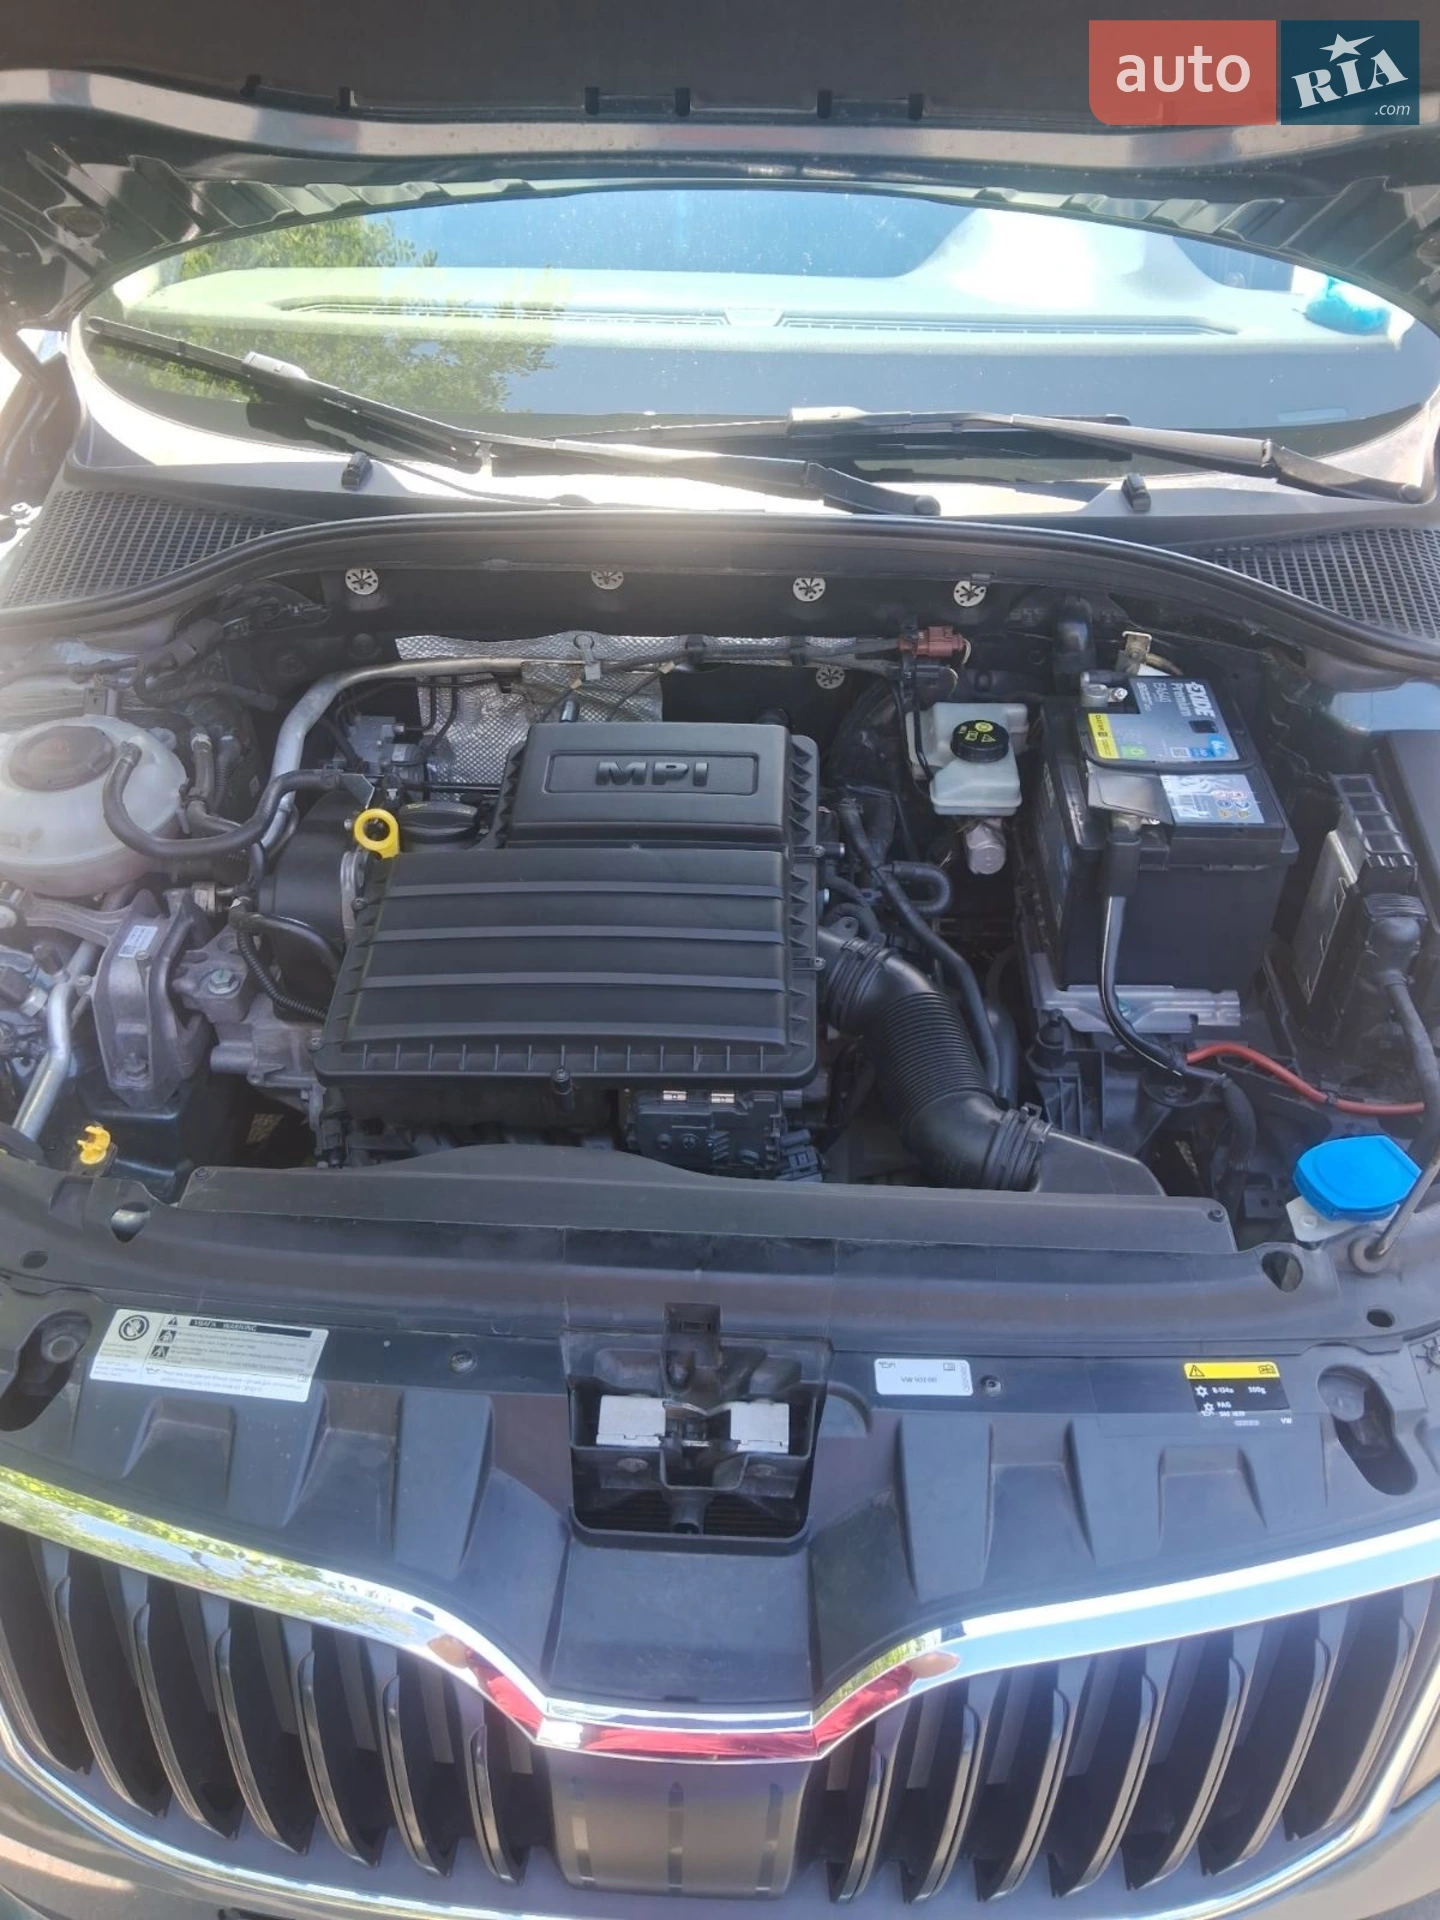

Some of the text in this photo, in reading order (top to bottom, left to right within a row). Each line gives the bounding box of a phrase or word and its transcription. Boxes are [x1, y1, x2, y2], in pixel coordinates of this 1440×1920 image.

[1171, 682, 1191, 717] Premium
[1185, 681, 1216, 719] EXIDE
[595, 761, 709, 787] MPI
[222, 1322, 258, 1332] WARNING
